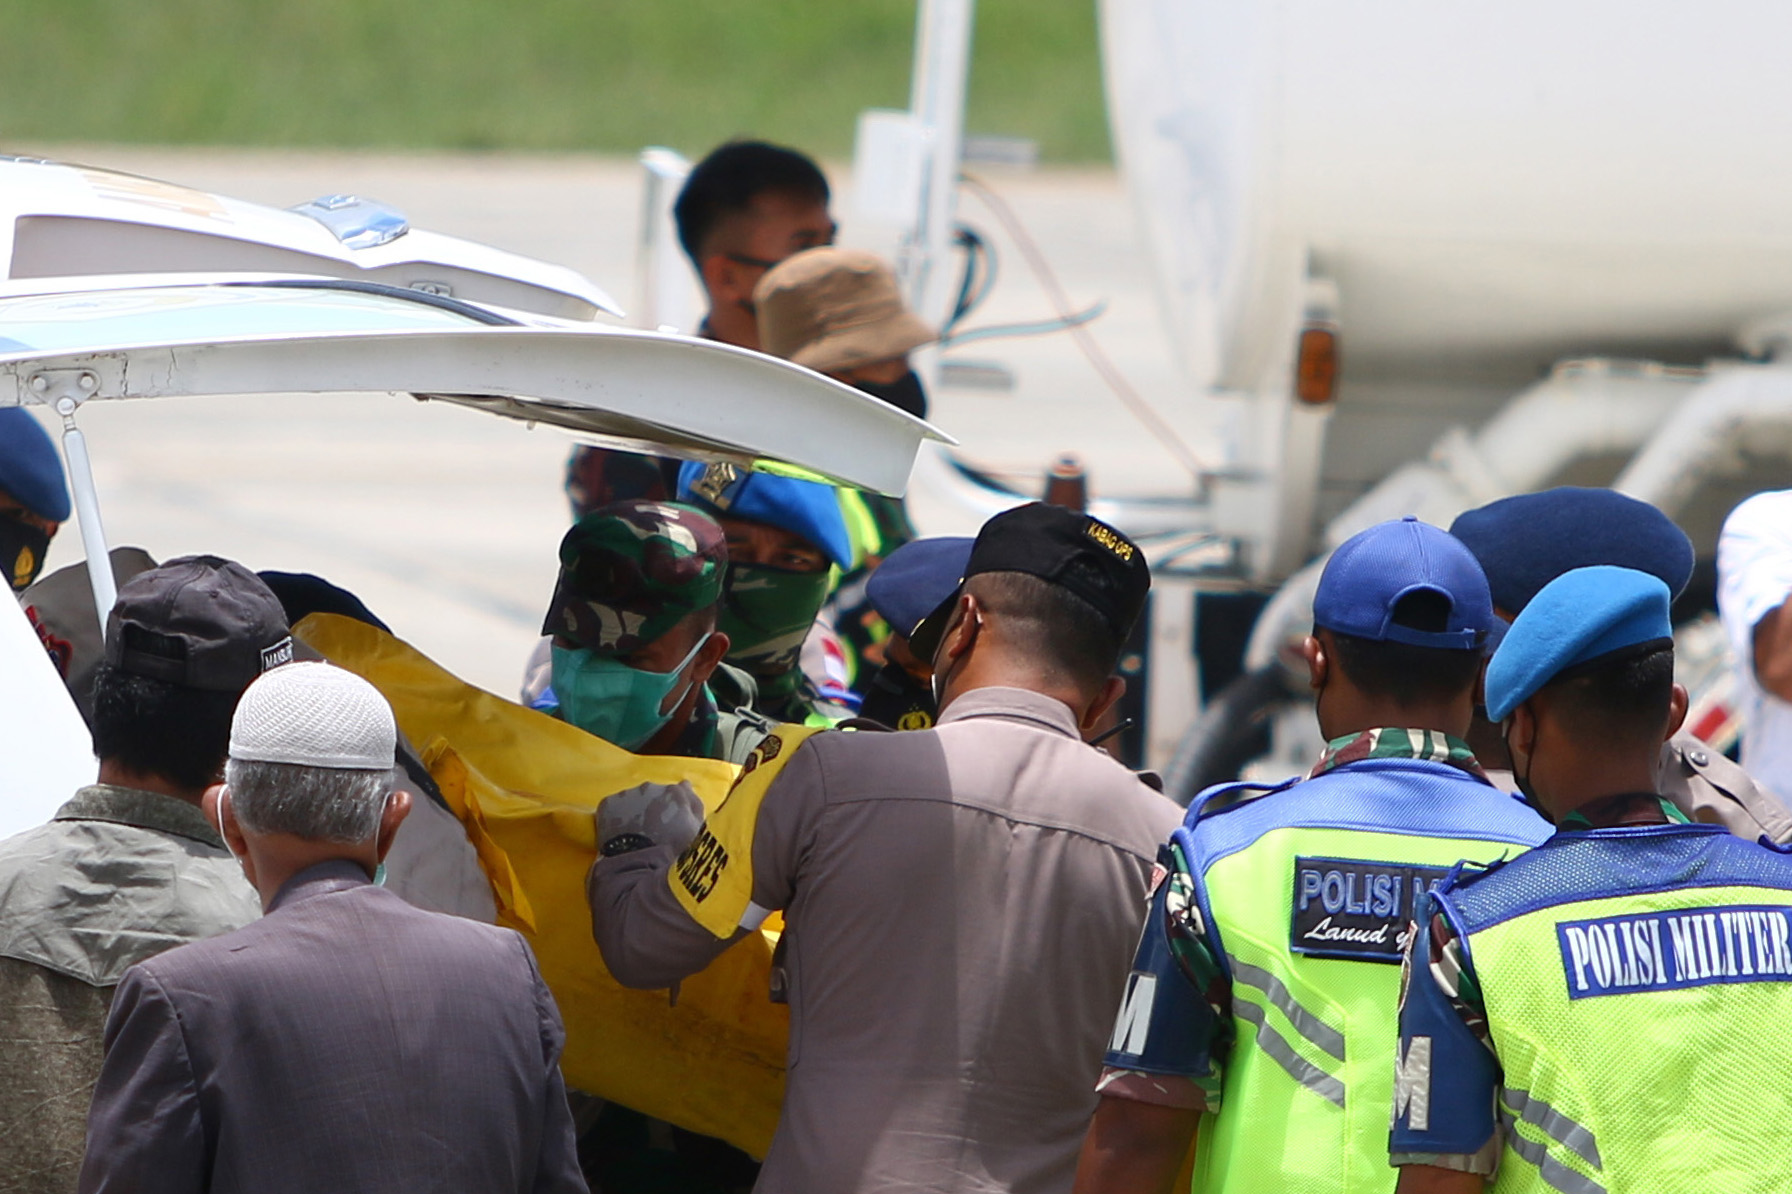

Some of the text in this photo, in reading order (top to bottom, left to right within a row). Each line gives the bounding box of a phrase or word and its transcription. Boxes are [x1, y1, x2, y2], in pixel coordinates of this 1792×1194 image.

[1300, 869, 1402, 918] POLISI
[1304, 916, 1389, 944] Lanud
[1565, 911, 1792, 991] POLISI MILITER
